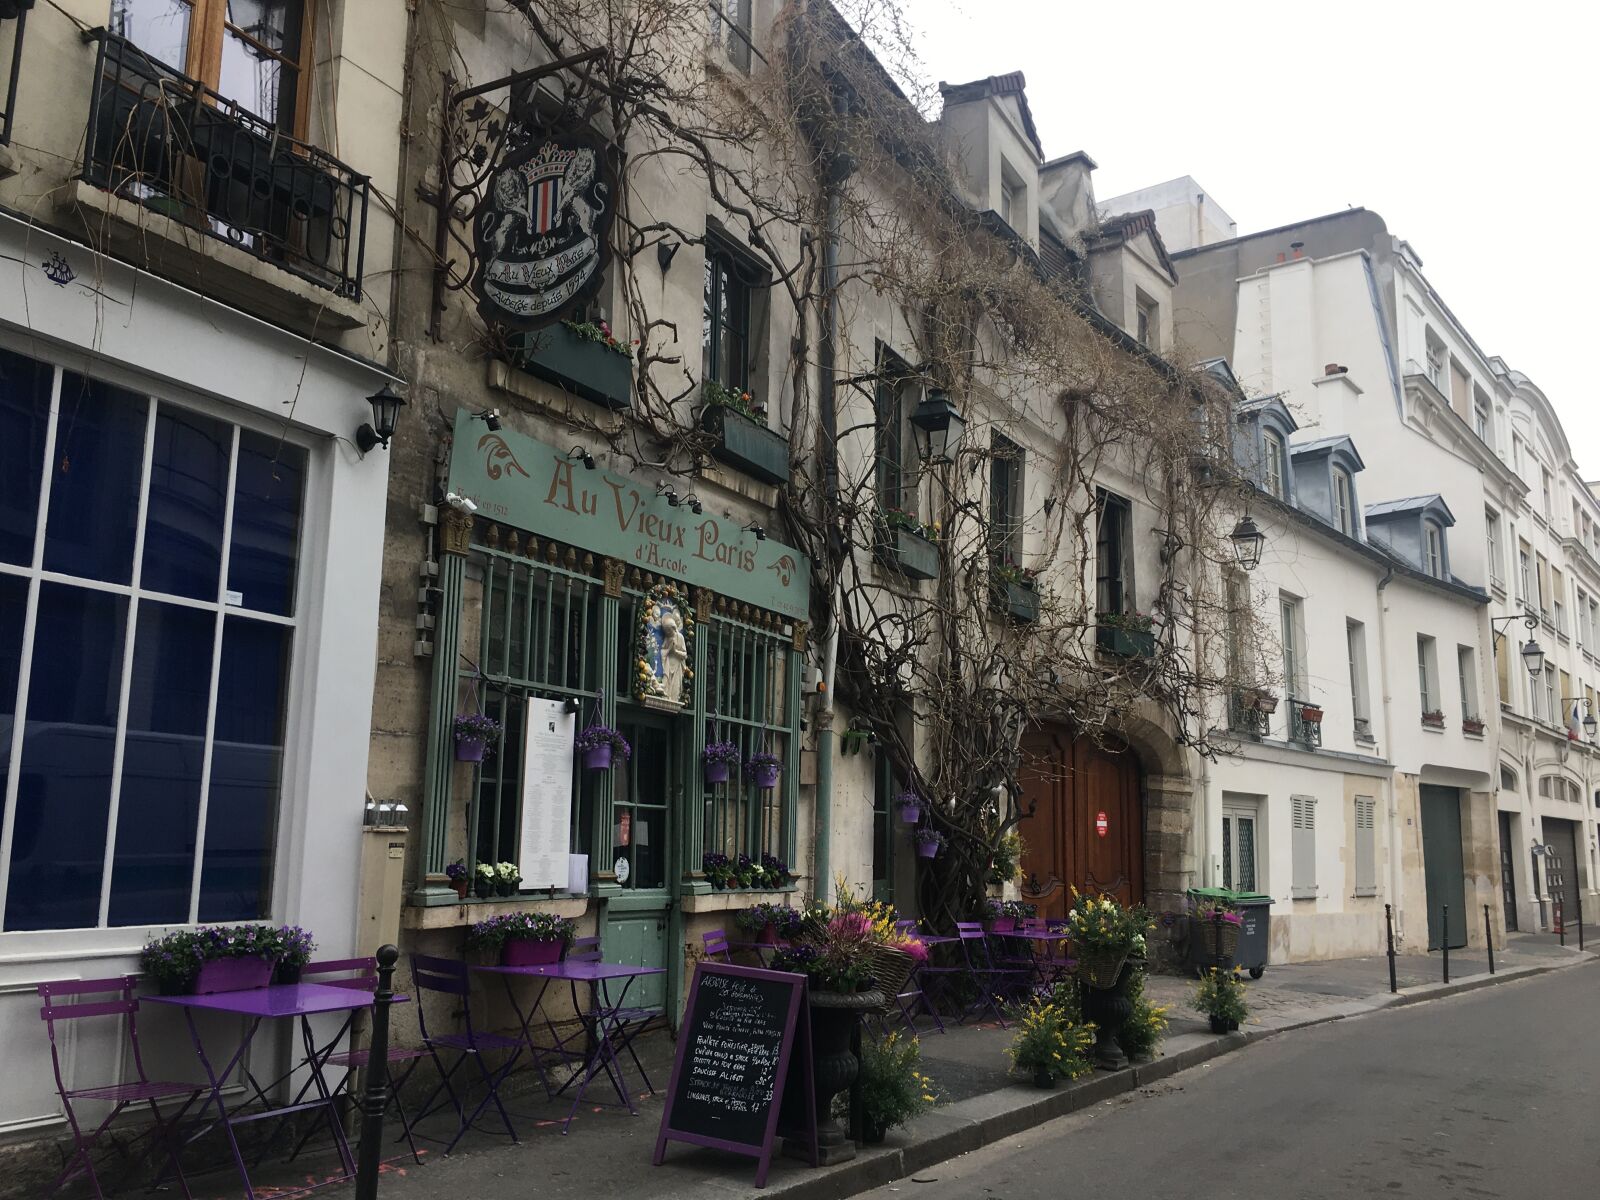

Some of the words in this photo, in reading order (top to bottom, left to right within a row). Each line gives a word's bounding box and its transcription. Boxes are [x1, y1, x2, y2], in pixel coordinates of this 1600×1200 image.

[498, 264, 519, 282] Au
[521, 262, 553, 282] Vieux
[555, 247, 584, 273] Paris
[492, 291, 528, 313] Auberge
[530, 290, 562, 312] depuis
[543, 455, 597, 515] Au
[602, 475, 686, 548] Vieux
[692, 520, 755, 573] Paris
[635, 543, 688, 576] d'Arcole
